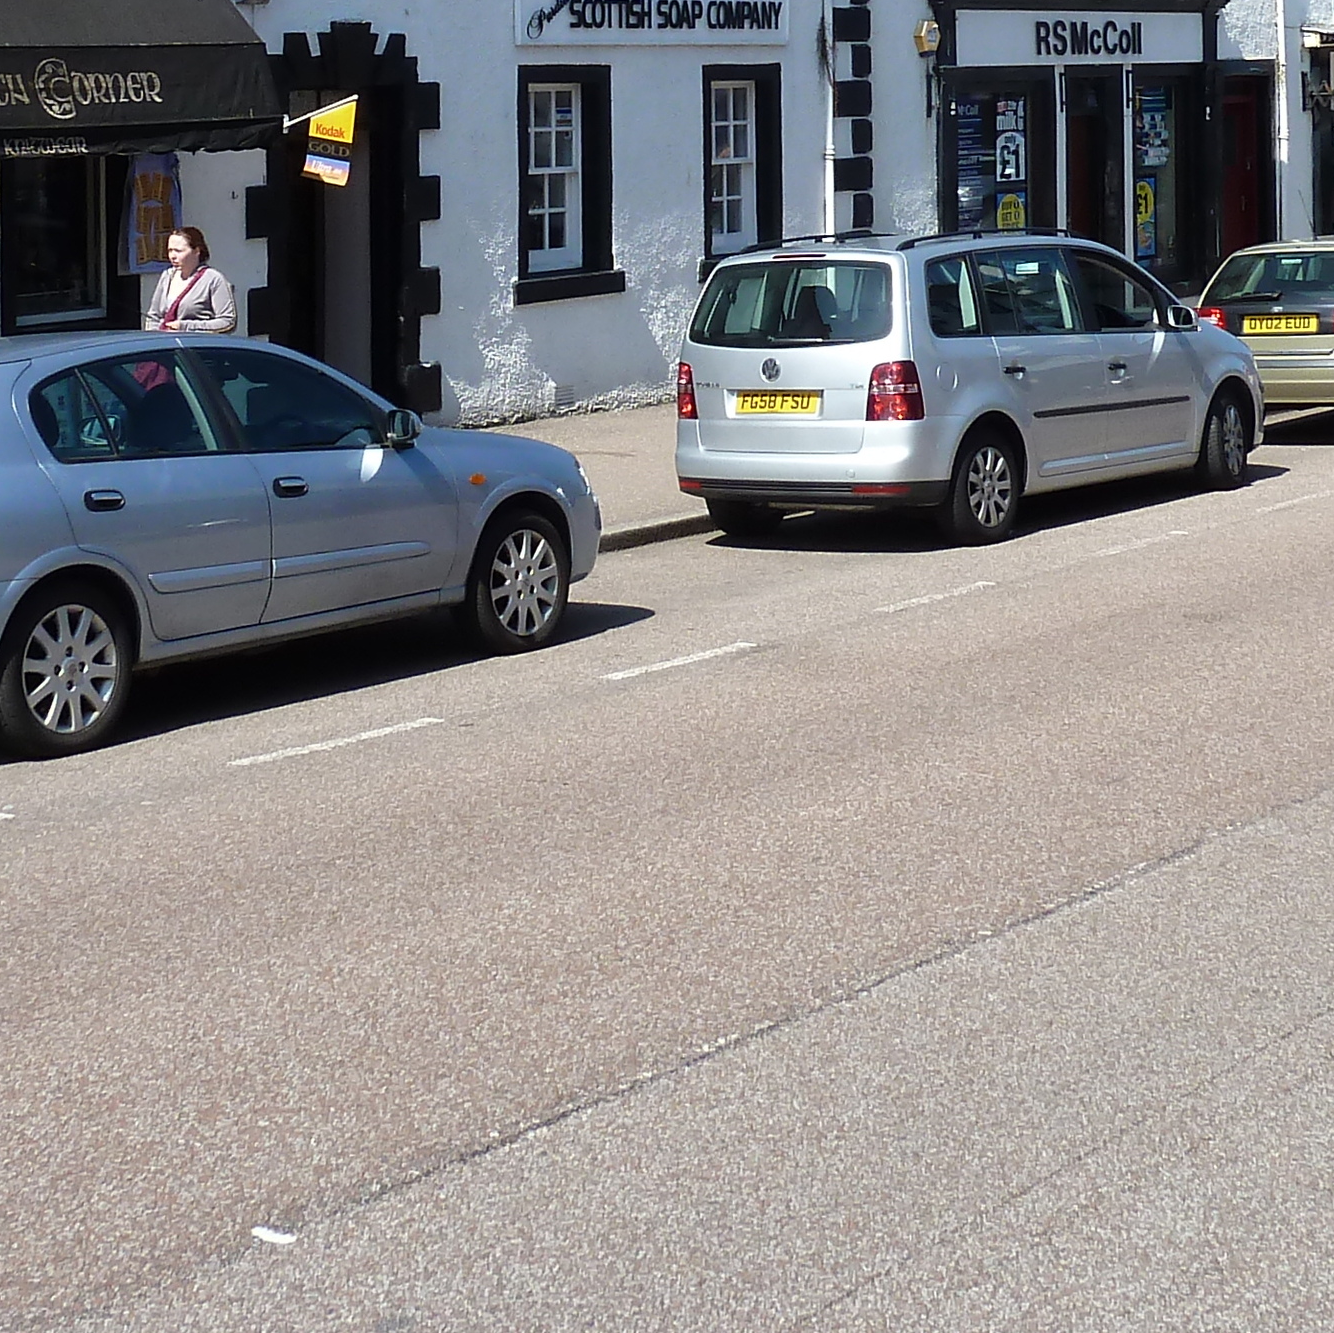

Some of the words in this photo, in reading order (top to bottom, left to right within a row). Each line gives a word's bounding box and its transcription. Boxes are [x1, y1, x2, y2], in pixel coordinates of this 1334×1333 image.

[656, 0, 704, 29] SOAP
[707, 0, 783, 30] COMPANY
[315, 123, 346, 139] Kodak
[308, 141, 350, 157] GOLD
[999, 143, 1021, 180] £1
[740, 393, 777, 410] FG58
[780, 394, 811, 410] FSU
